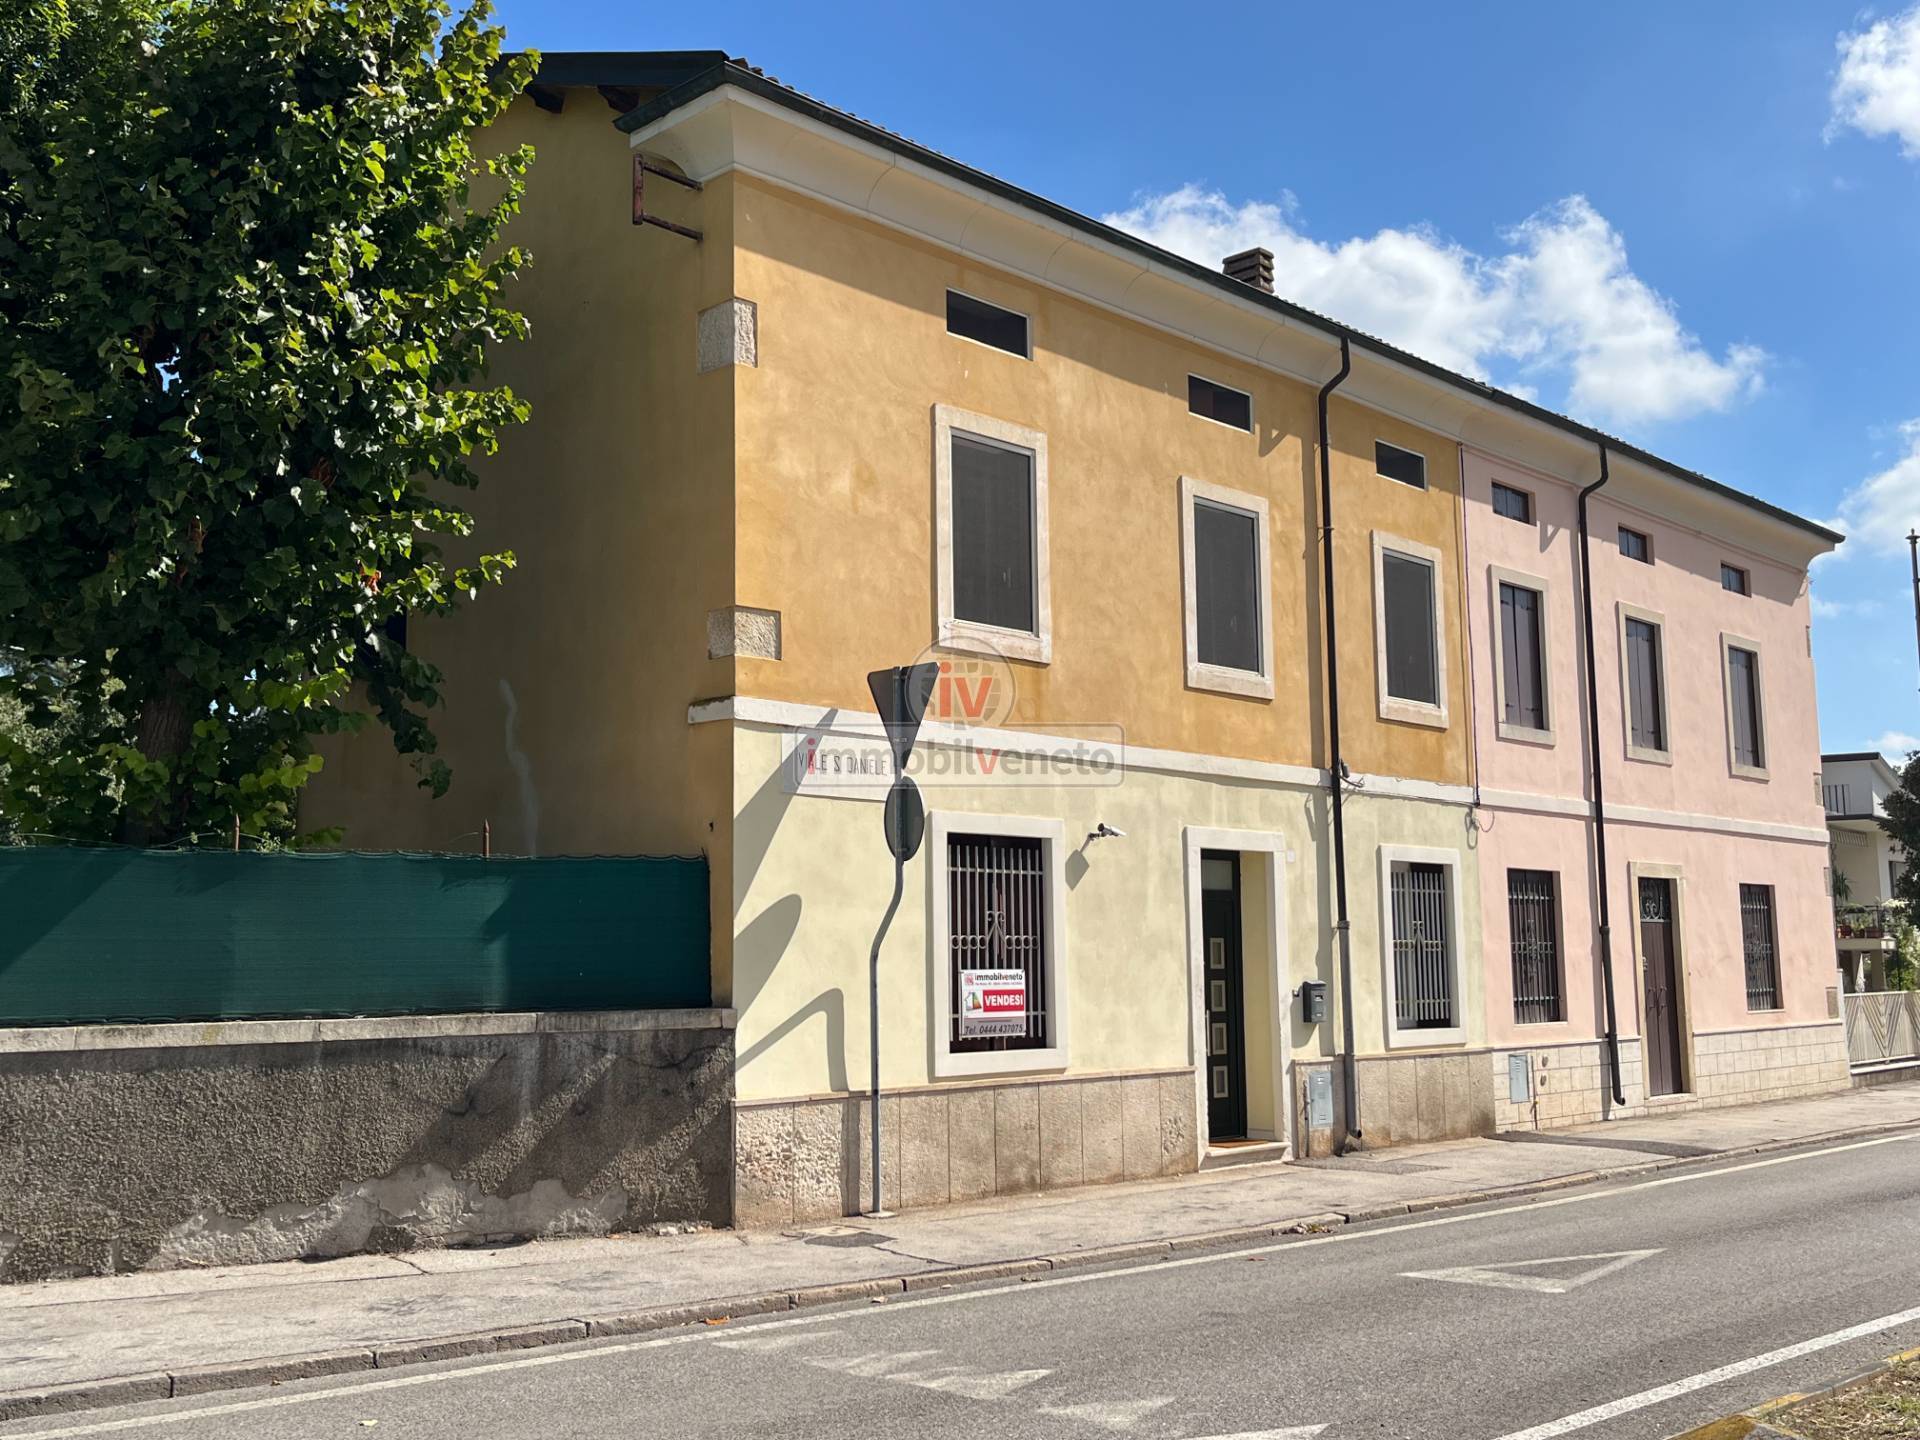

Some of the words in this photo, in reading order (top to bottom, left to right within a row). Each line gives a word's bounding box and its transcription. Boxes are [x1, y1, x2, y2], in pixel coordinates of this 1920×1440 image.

[846, 756, 888, 776] DANIELE
[975, 972, 1023, 981] immobilveneto
[984, 994, 1023, 1006] VENDESI
[980, 1024, 997, 1034] 0444
